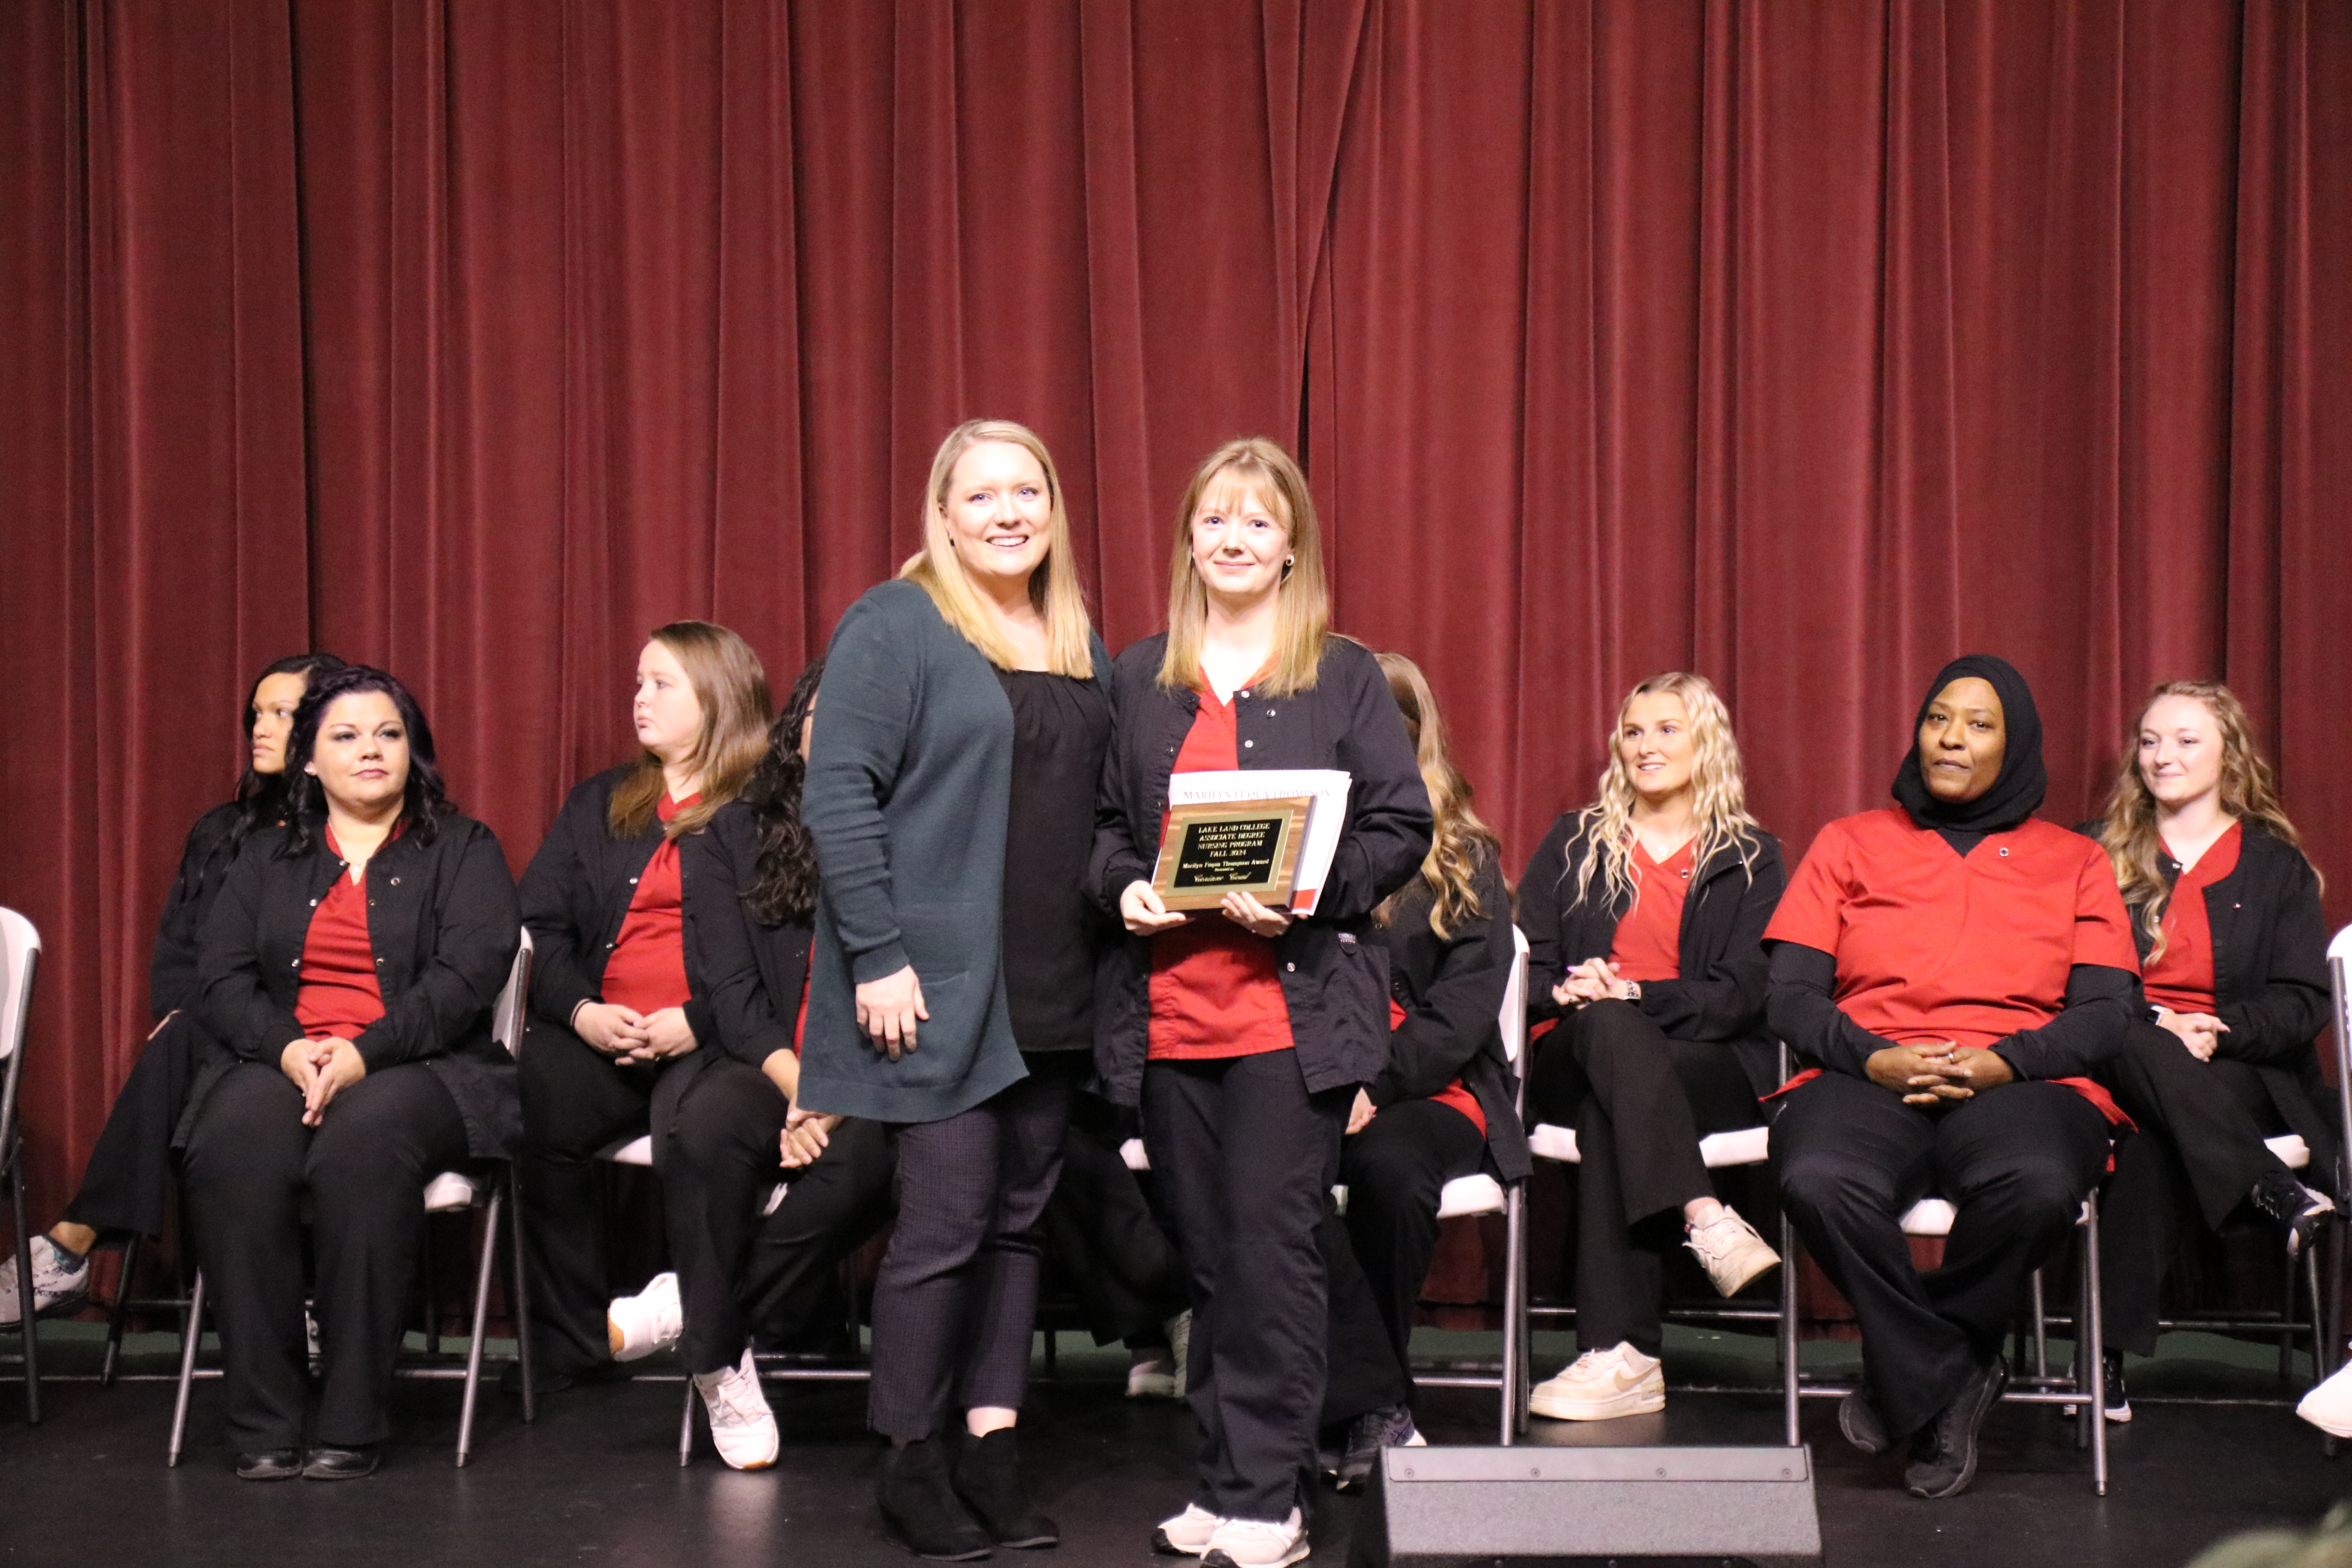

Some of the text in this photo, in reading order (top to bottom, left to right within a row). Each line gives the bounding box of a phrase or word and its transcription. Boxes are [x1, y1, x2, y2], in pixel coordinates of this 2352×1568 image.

[1184, 789, 1330, 799] MARILYN FUQUA THOMPSON
[1199, 833, 1236, 841] ASSOCIATE
[1198, 842, 1227, 850] NURSING
